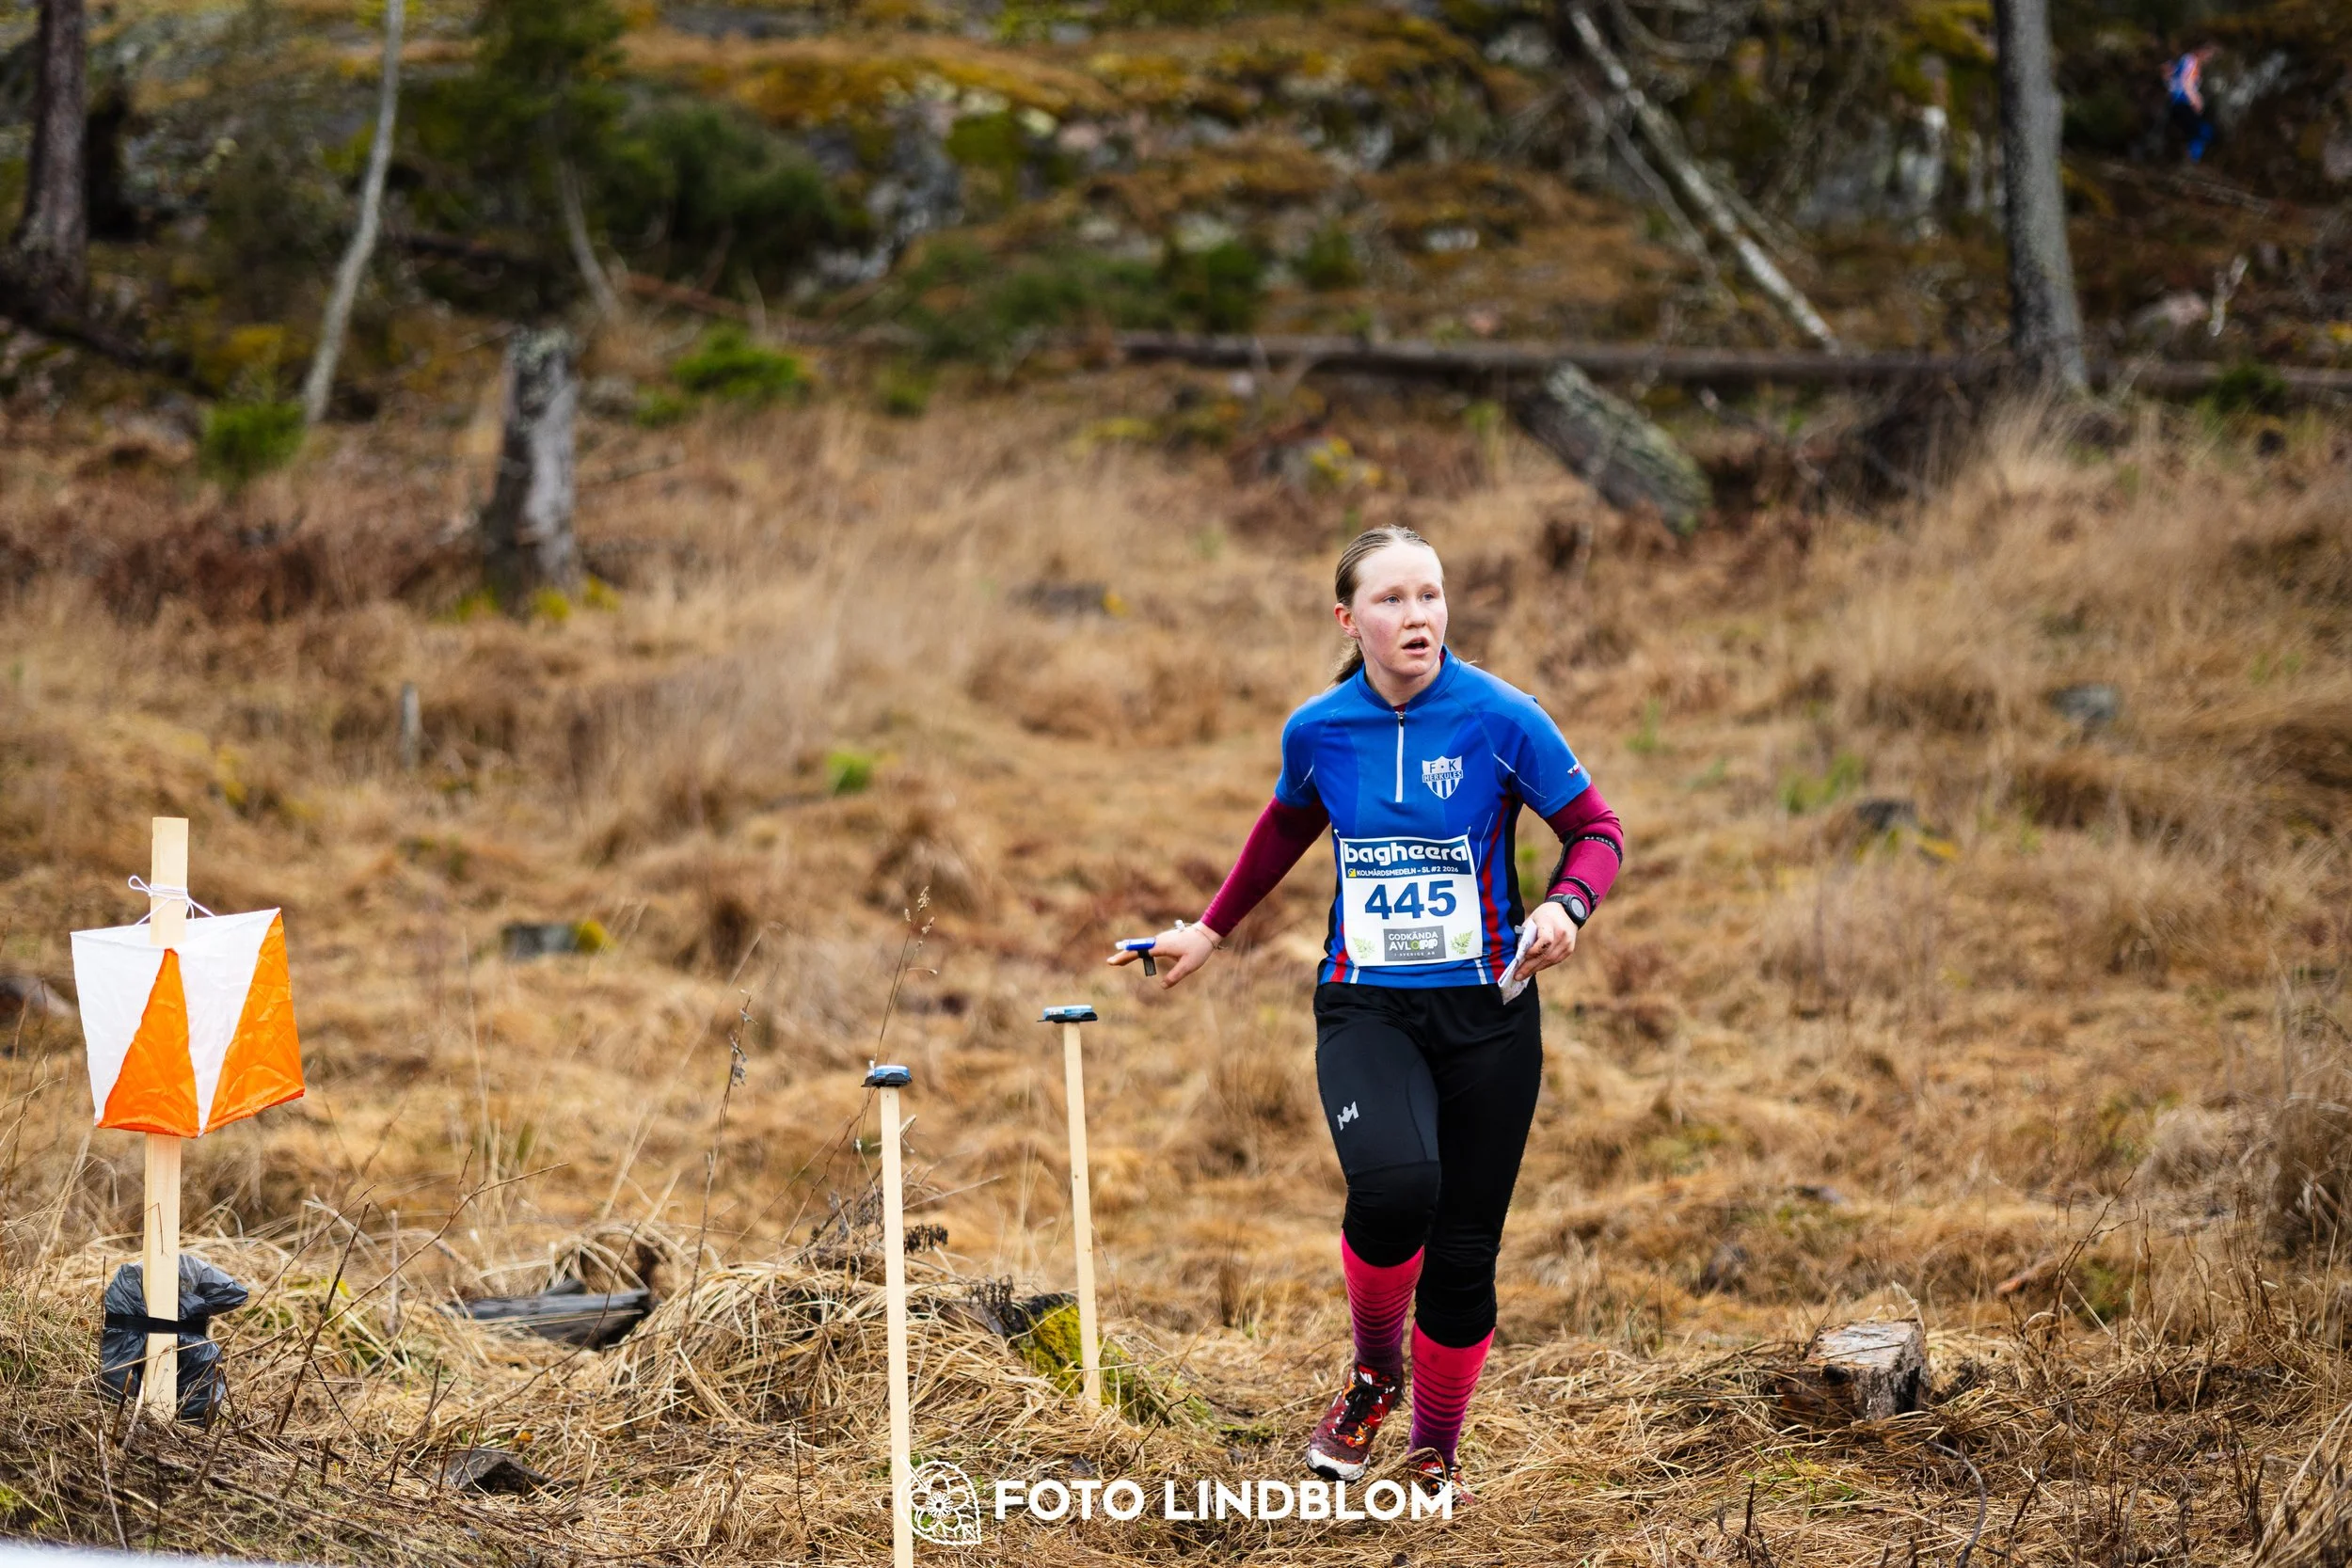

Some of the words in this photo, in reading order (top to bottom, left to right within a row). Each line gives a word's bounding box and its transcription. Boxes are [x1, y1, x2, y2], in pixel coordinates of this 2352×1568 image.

[1423, 770, 1462, 782] HERKULES
[1344, 842, 1468, 866] bagheera
[1356, 867, 1417, 877] KOLMÅRDSMEDELN
[1364, 879, 1457, 920] 445
[1388, 930, 1438, 941] GODKÄNDA
